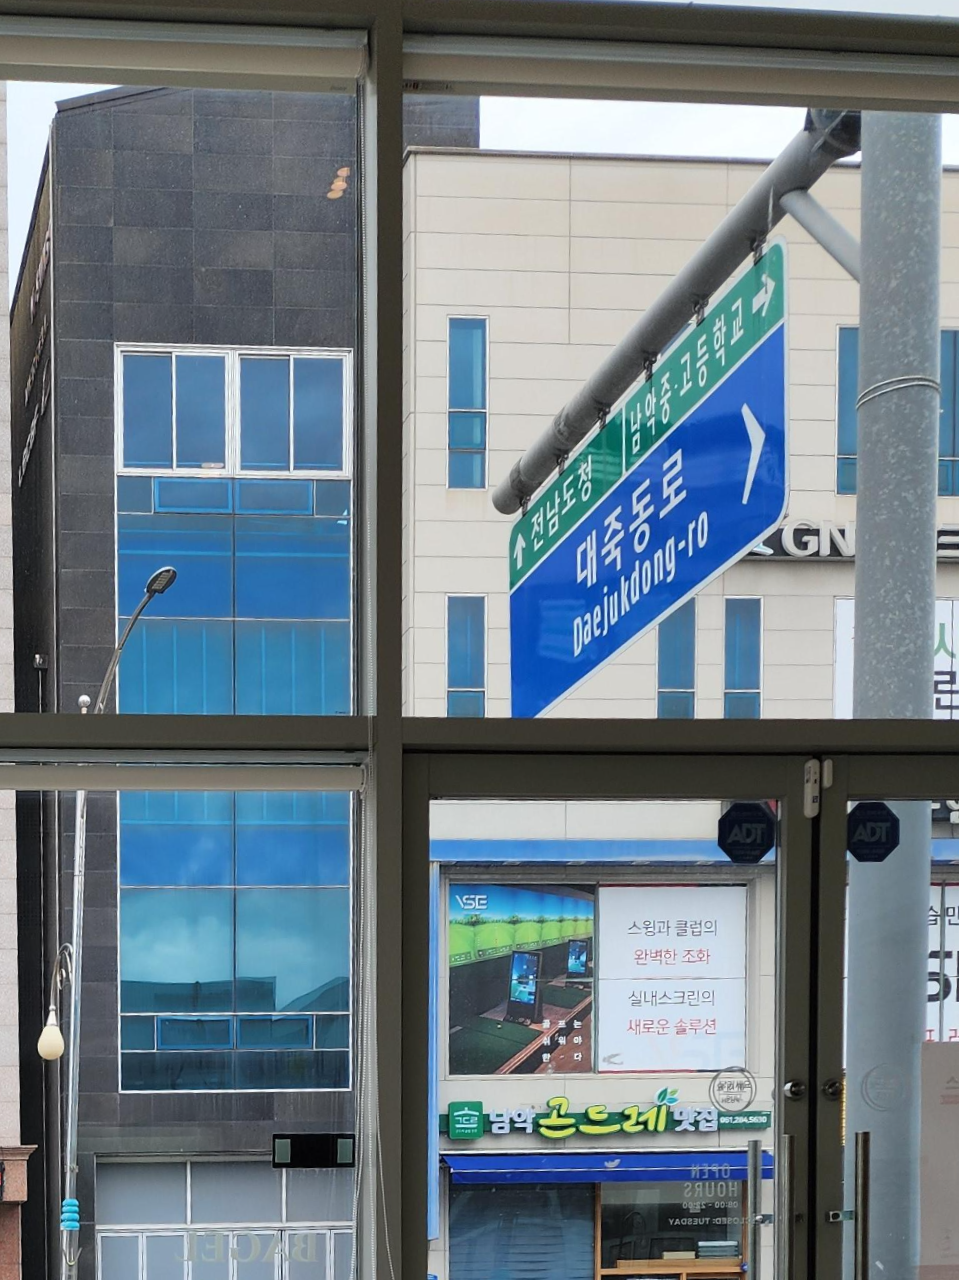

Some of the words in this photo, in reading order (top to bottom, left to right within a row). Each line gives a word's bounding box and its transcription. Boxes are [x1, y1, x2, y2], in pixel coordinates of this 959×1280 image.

[530, 454, 593, 549] 전남도청
[576, 448, 688, 590] 대죽동로
[572, 510, 709, 658] Daejukdong-ro
[726, 823, 767, 843] ADT
[851, 822, 891, 842] ADT
[627, 920, 671, 937] 스윙과
[674, 919, 718, 937] 클럽의
[633, 949, 678, 966] 완벽한
[682, 949, 711, 966] 조화
[628, 990, 716, 1007] 실내스크린의
[626, 1018, 671, 1034] 새로운
[674, 1018, 718, 1036] 솔루션
[489, 1107, 536, 1134] 남악
[539, 1096, 670, 1139] 곤드레
[674, 1106, 719, 1132] 맛집
